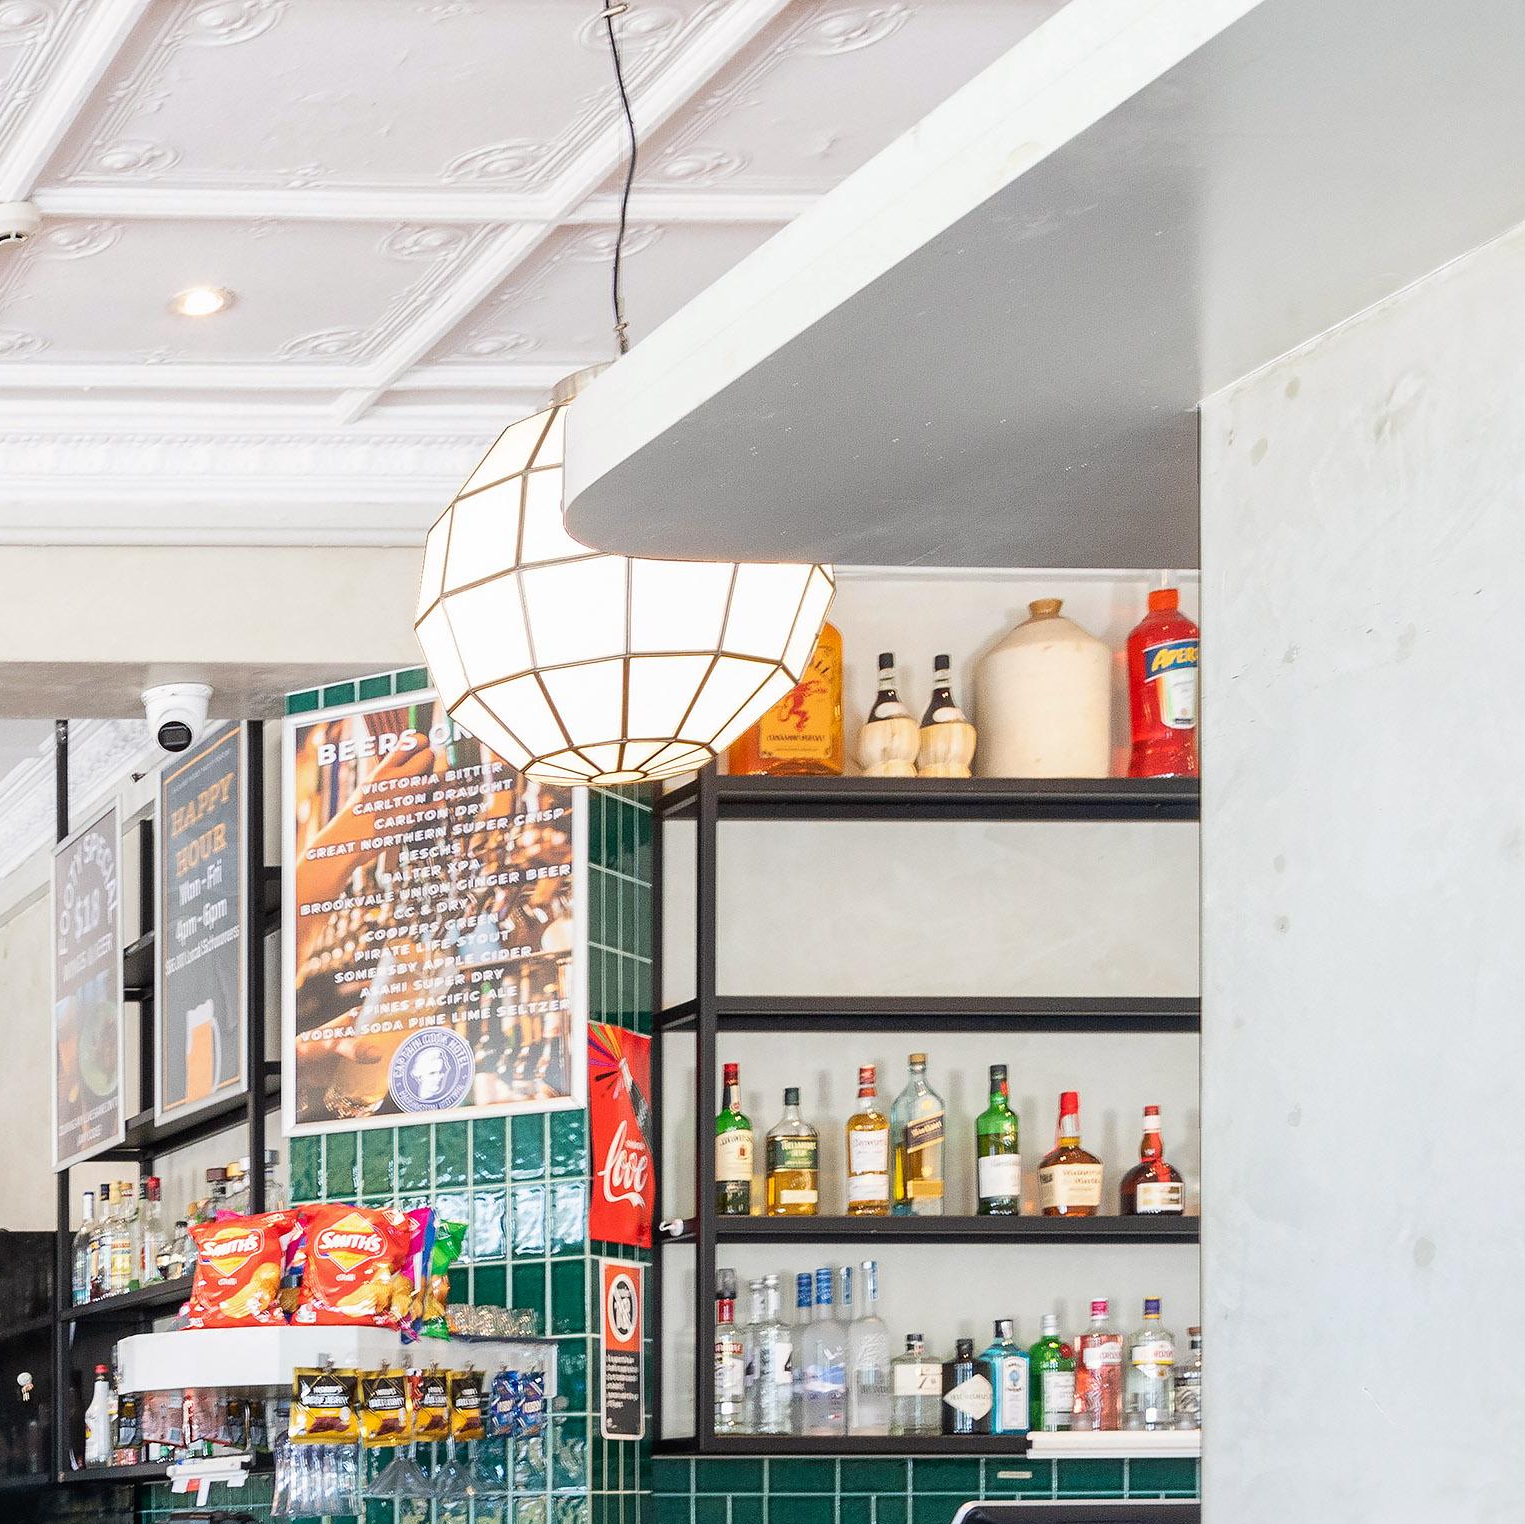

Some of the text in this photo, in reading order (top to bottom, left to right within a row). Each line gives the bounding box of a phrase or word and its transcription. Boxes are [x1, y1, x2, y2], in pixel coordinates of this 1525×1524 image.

[1151, 646, 1199, 672] APER
[317, 727, 418, 767] BEERS
[360, 761, 503, 796] VICTORIA BITTER
[170, 772, 235, 838] HAPPY
[352, 778, 513, 816] CARLTON DRAUGHT
[373, 802, 490, 831] CARLTON DRY
[175, 822, 227, 877] HOUR
[306, 807, 565, 862] GREAT NORTHERN SUPER CRISP
[398, 842, 462, 863] RESCHS
[382, 859, 482, 884] BALTER XPA
[300, 863, 571, 917] BROOKVALE UNION GINGER BEER
[393, 896, 470, 920] CC & DRY
[363, 913, 499, 943] COOPERS GREEN
[354, 930, 510, 963] PIRATE LIFE STOUT
[333, 945, 532, 984] SOMERSBY APPLE CIDER
[358, 968, 505, 999] ASAHI SUPER DRY
[364, 1000, 410, 1018] PINES
[414, 989, 480, 1010] PACIFIC
[485, 984, 518, 999] ALE
[300, 999, 570, 1043] VODKA SODA PINE LIME SELTZER
